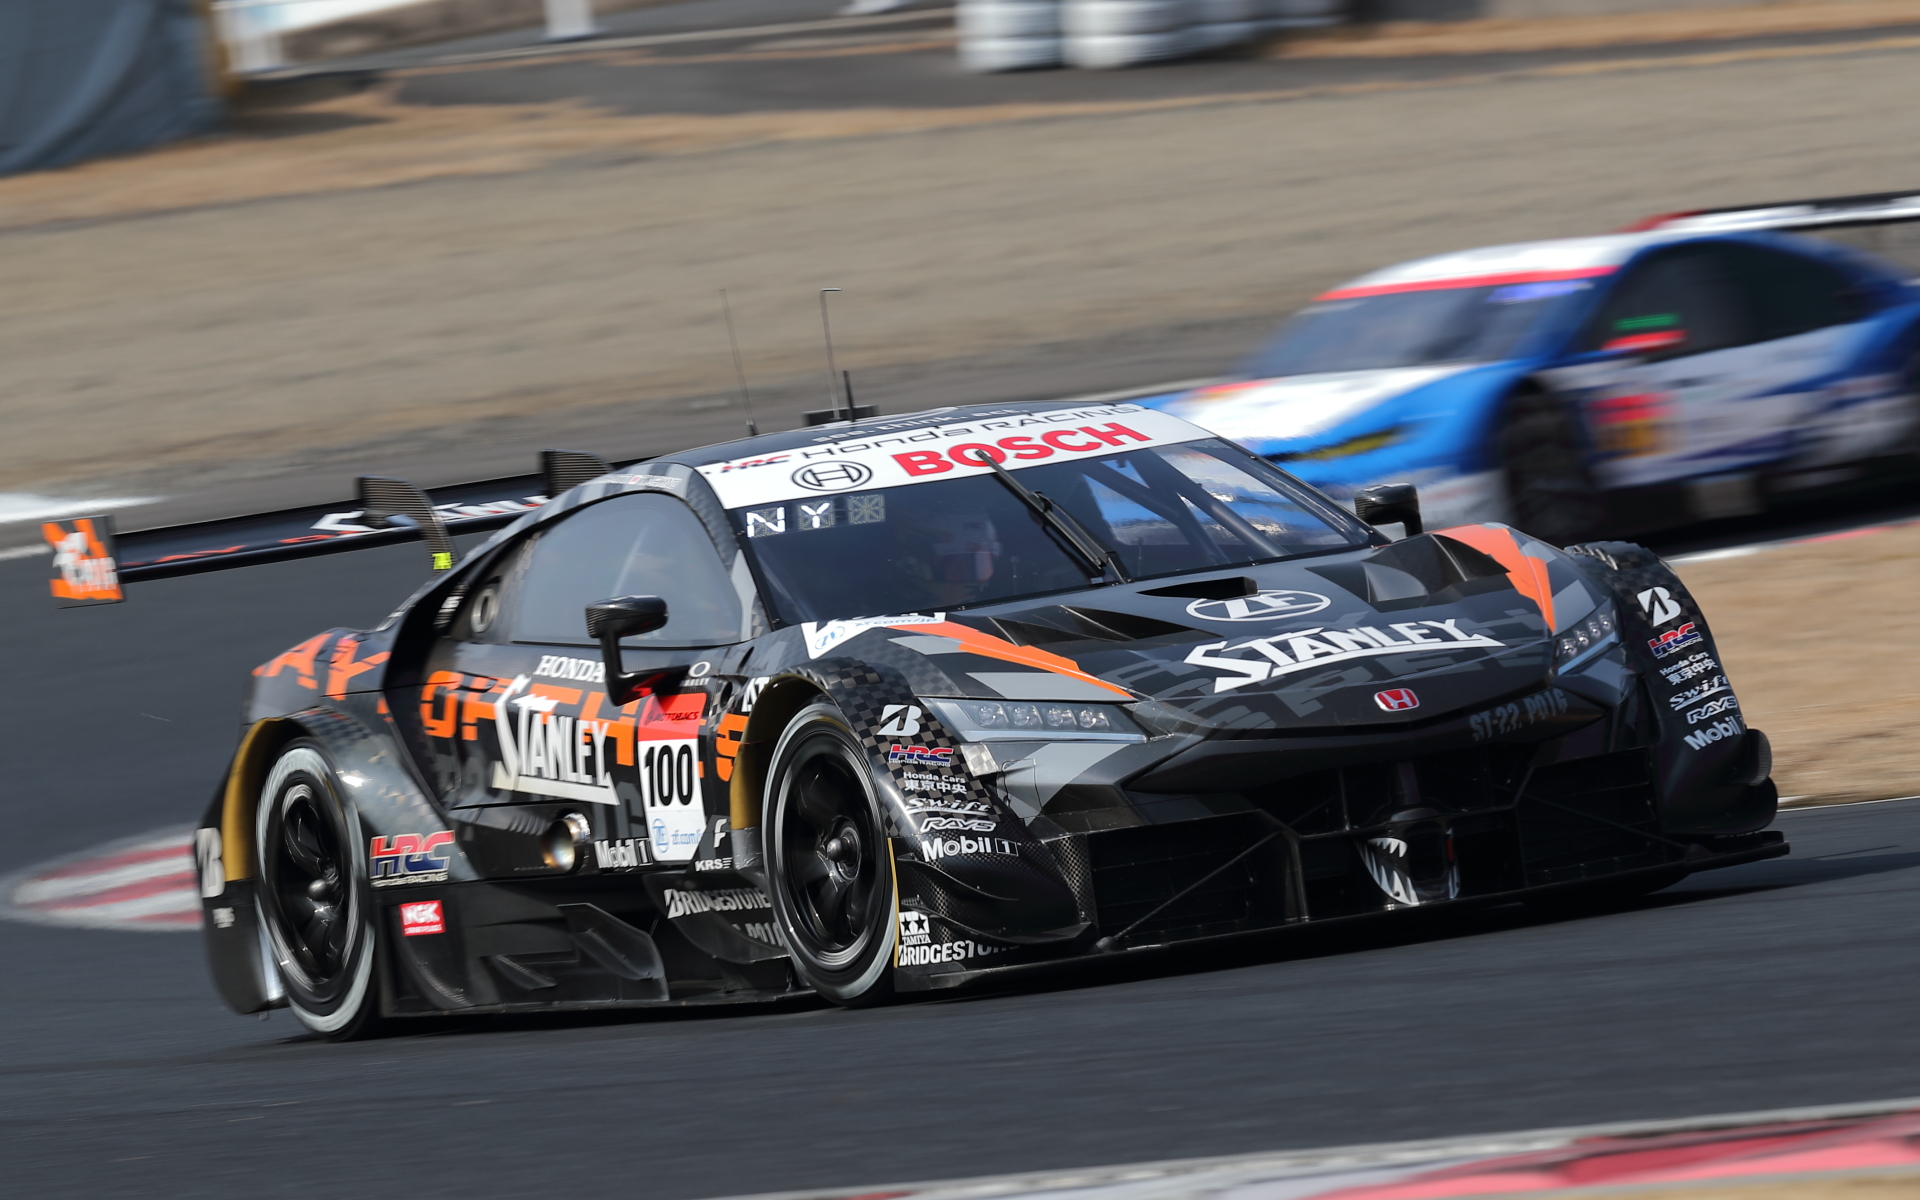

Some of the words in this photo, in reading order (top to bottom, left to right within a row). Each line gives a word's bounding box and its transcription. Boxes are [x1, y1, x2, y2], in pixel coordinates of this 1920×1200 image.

[802, 425, 976, 459] Honda
[979, 406, 1141, 431] RACING
[890, 421, 1152, 477] BOSCH
[1647, 621, 1701, 657] HRC
[533, 655, 606, 683] HONDA
[1182, 618, 1506, 694] STANLEY
[1659, 658, 1690, 676] Honda
[1687, 651, 1709, 662] Cars
[1685, 695, 1739, 725] RAYS
[492, 673, 620, 806] STANLEY
[1683, 715, 1742, 751] Mobil
[889, 743, 954, 764] HRC
[643, 744, 694, 808] 100
[903, 771, 939, 781] Honda
[941, 775, 966, 784] Cars
[904, 780, 968, 795] 東京中央
[904, 797, 992, 813] Swift
[920, 816, 997, 833] RAYS
[369, 829, 456, 880] HRC
[594, 839, 638, 869] Mobil
[920, 835, 992, 863] Mobil
[663, 888, 773, 920] BRIDGESTONE
[901, 933, 932, 946] TAMIYA
